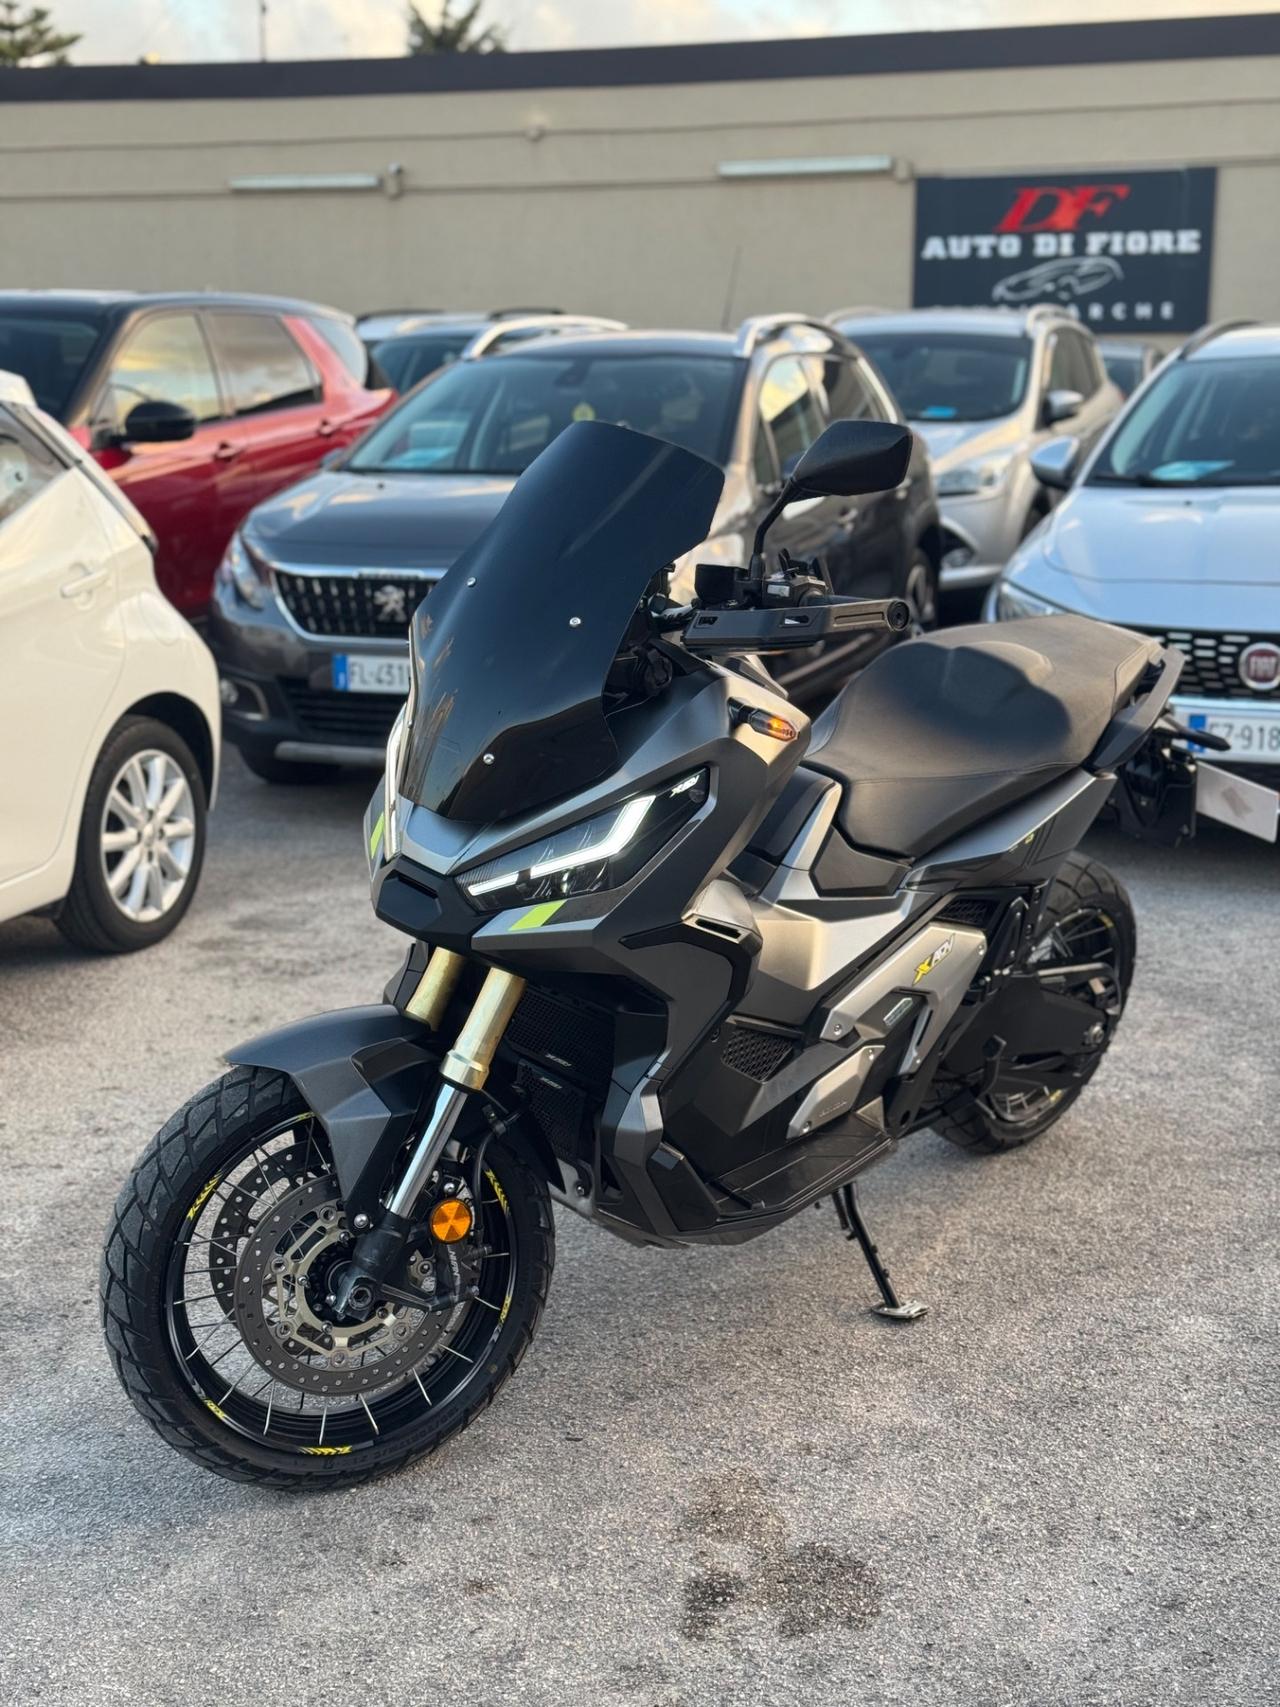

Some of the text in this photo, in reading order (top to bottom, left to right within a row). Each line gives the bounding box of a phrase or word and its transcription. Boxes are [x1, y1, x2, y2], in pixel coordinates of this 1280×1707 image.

[994, 184, 1130, 233] DF
[921, 229, 1201, 259] AUTO DI FIORE
